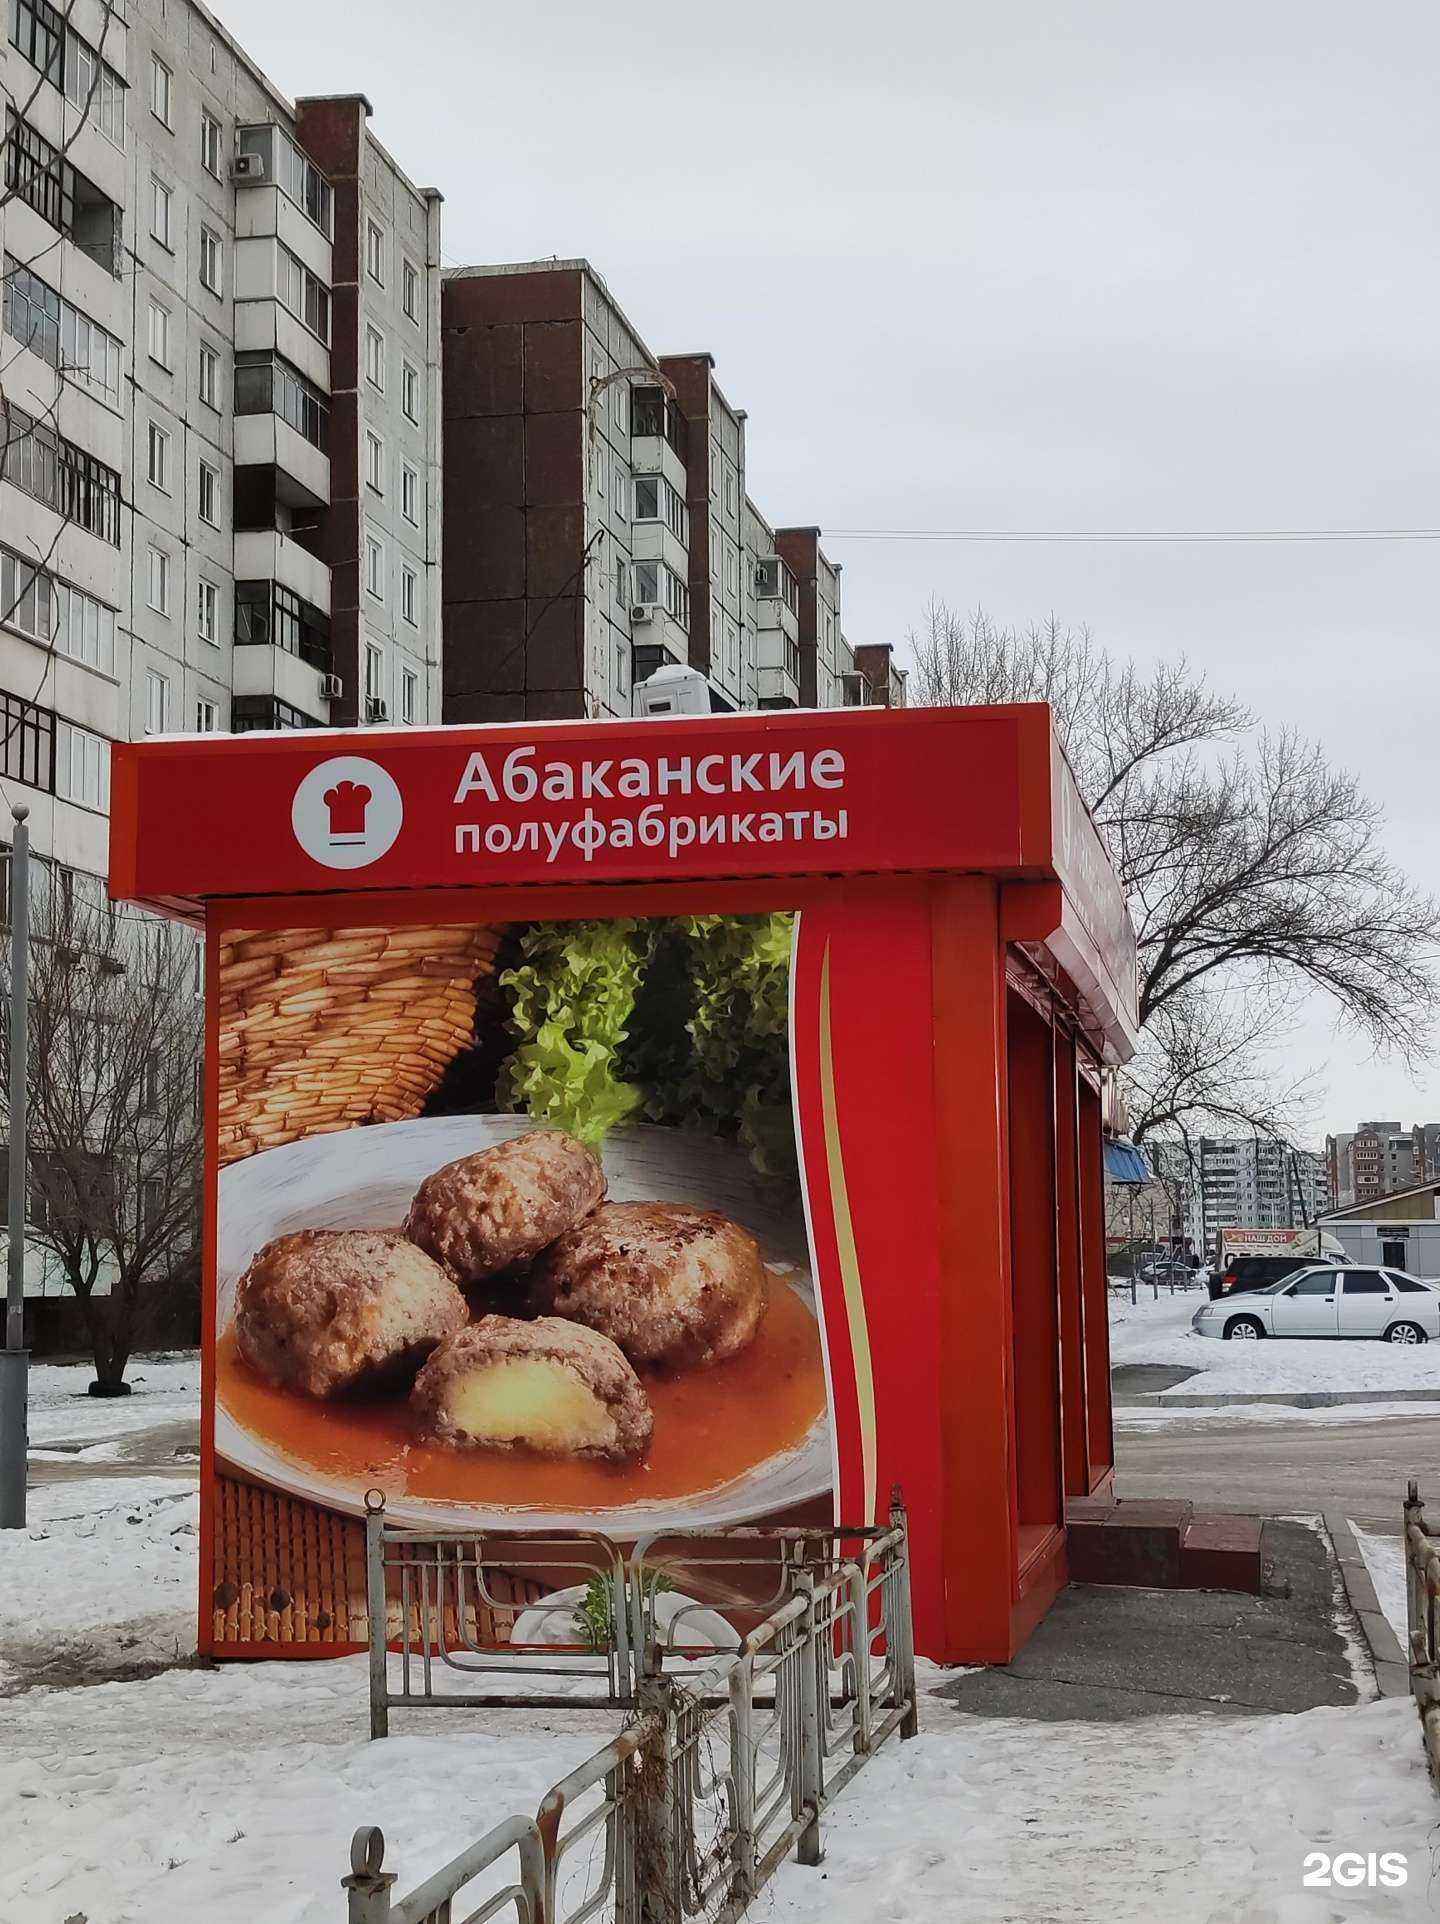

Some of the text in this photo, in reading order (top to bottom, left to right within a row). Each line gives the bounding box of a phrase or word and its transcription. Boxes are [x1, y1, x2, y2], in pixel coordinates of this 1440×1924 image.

[454, 746, 845, 803] Абаканские
[456, 804, 848, 862] полуфабрикаты
[1244, 1234, 1265, 1242] НАШ
